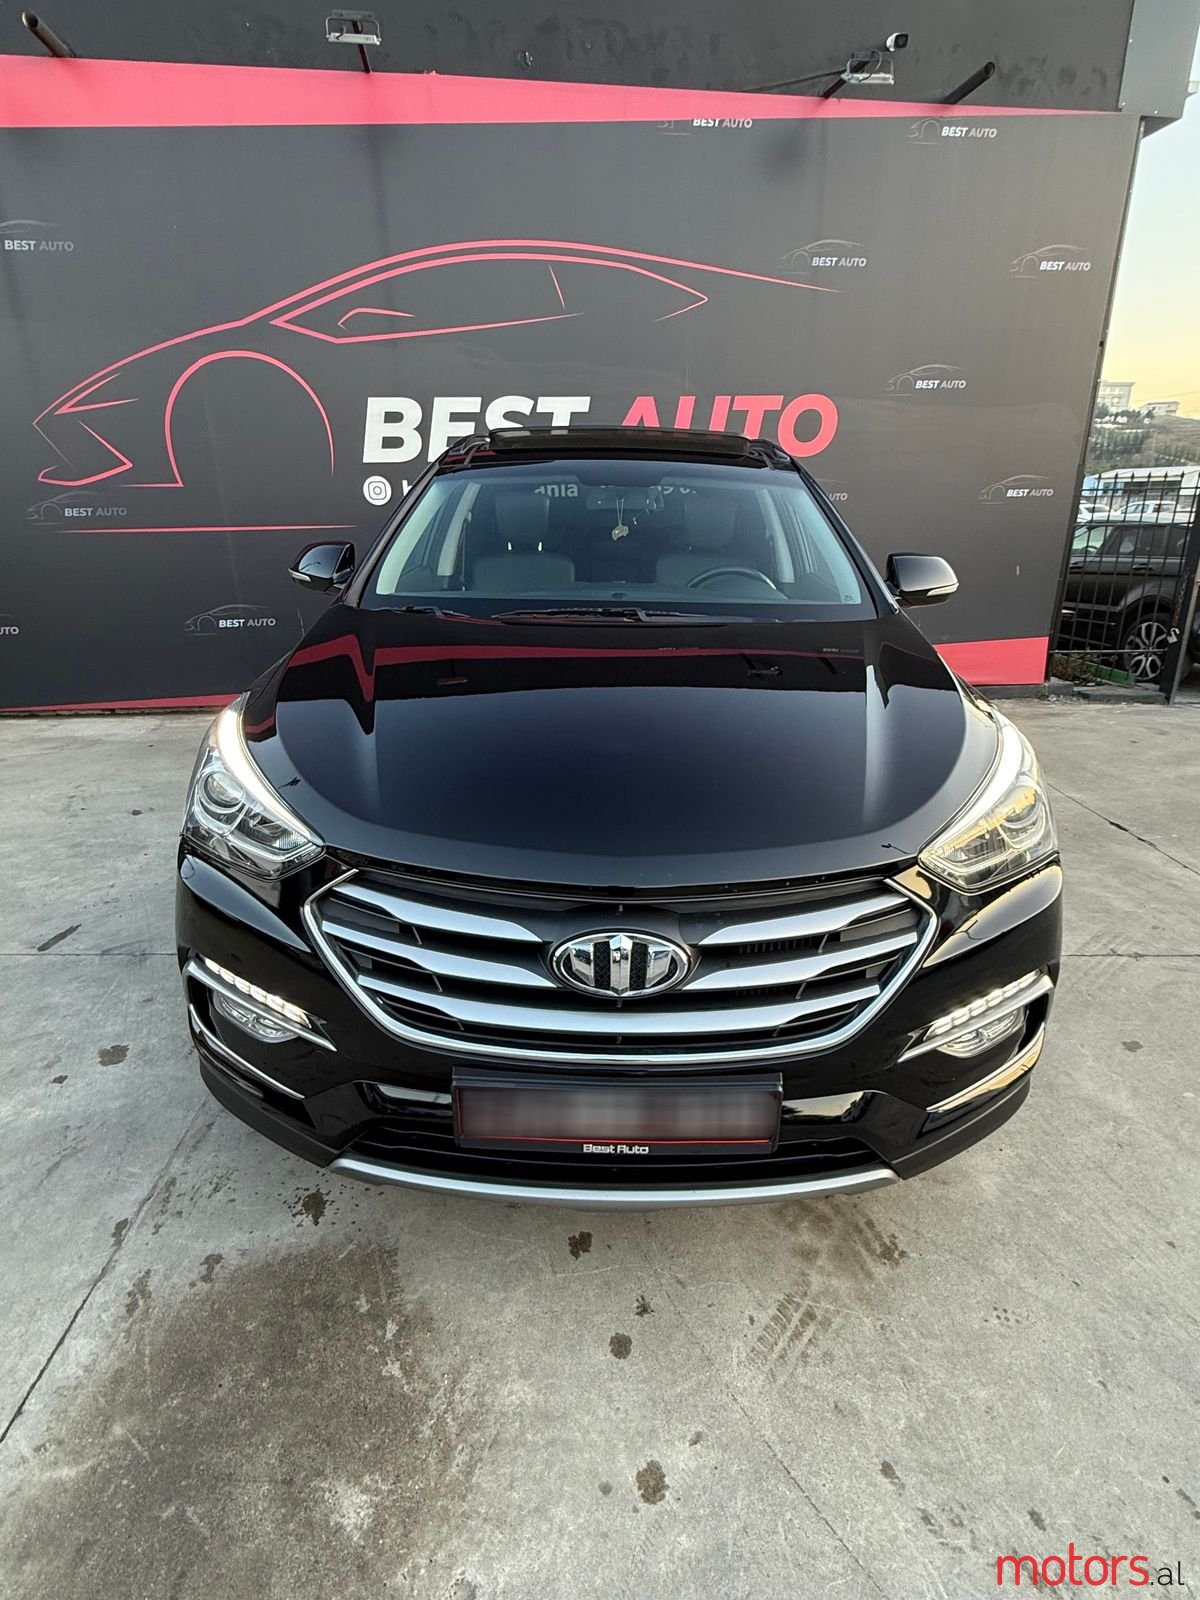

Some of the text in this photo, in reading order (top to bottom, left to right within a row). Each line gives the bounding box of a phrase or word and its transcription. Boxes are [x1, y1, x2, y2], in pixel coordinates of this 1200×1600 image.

[722, 118, 753, 128] AUTO
[941, 126, 997, 138] BEST AUTO
[4, 240, 74, 251] BEST AUTO
[811, 256, 867, 267] BEST AUTO
[1039, 261, 1091, 271] BEST AUTO
[915, 380, 967, 389] BEST AUTO
[1006, 488, 1054, 497] BEST AUTO
[64, 506, 127, 517] BEST AUTO
[218, 618, 276, 628] BEST AUTO
[583, 1143, 649, 1155] Best Auto
